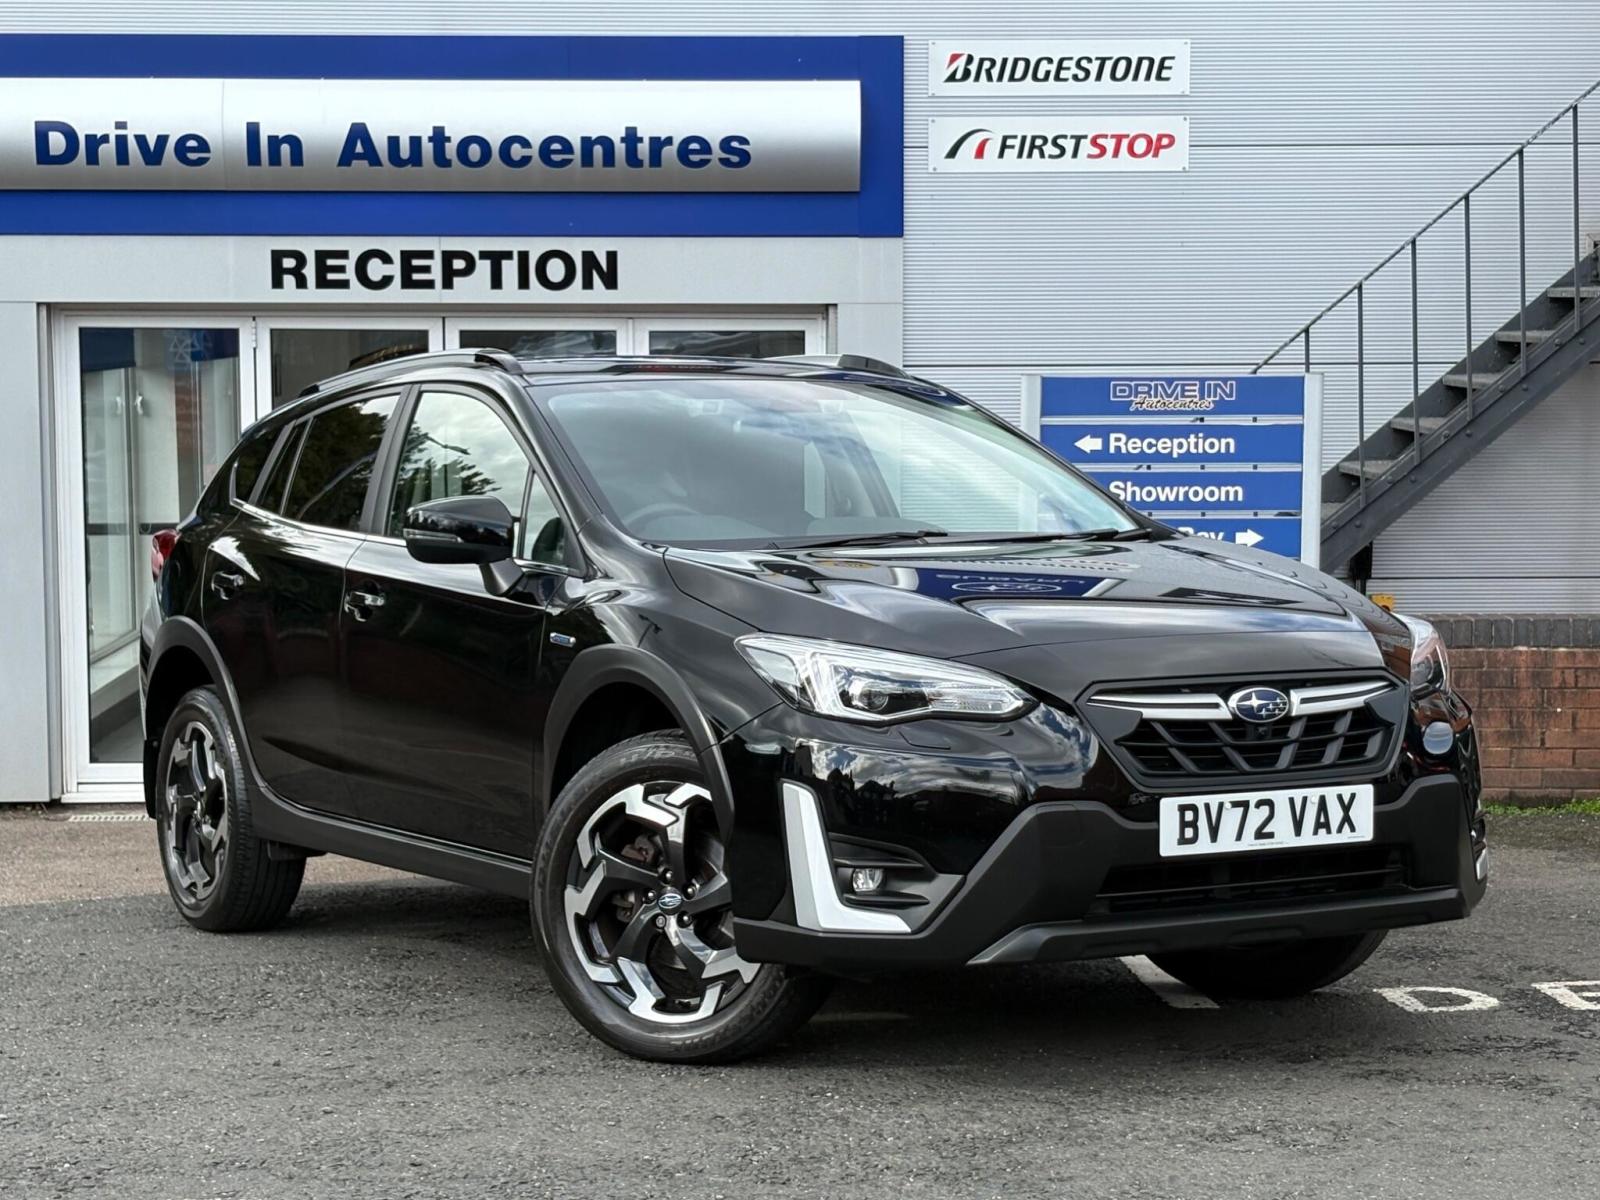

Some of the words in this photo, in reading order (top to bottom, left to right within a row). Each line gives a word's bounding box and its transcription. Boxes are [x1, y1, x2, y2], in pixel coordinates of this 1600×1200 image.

[943, 53, 1175, 82] BRIDGESTONE
[34, 121, 211, 166] Drive
[246, 122, 303, 166] In
[338, 122, 752, 169] Autocentres
[270, 249, 618, 291] RECEPTION
[1110, 381, 1199, 400] DRIVE
[1205, 381, 1236, 400] IN
[1129, 396, 1214, 411] Autocentres
[1109, 433, 1235, 457] Reception
[1109, 481, 1243, 501] Showroom
[1177, 798, 1275, 845] BV72
[1289, 793, 1356, 837] VAX
